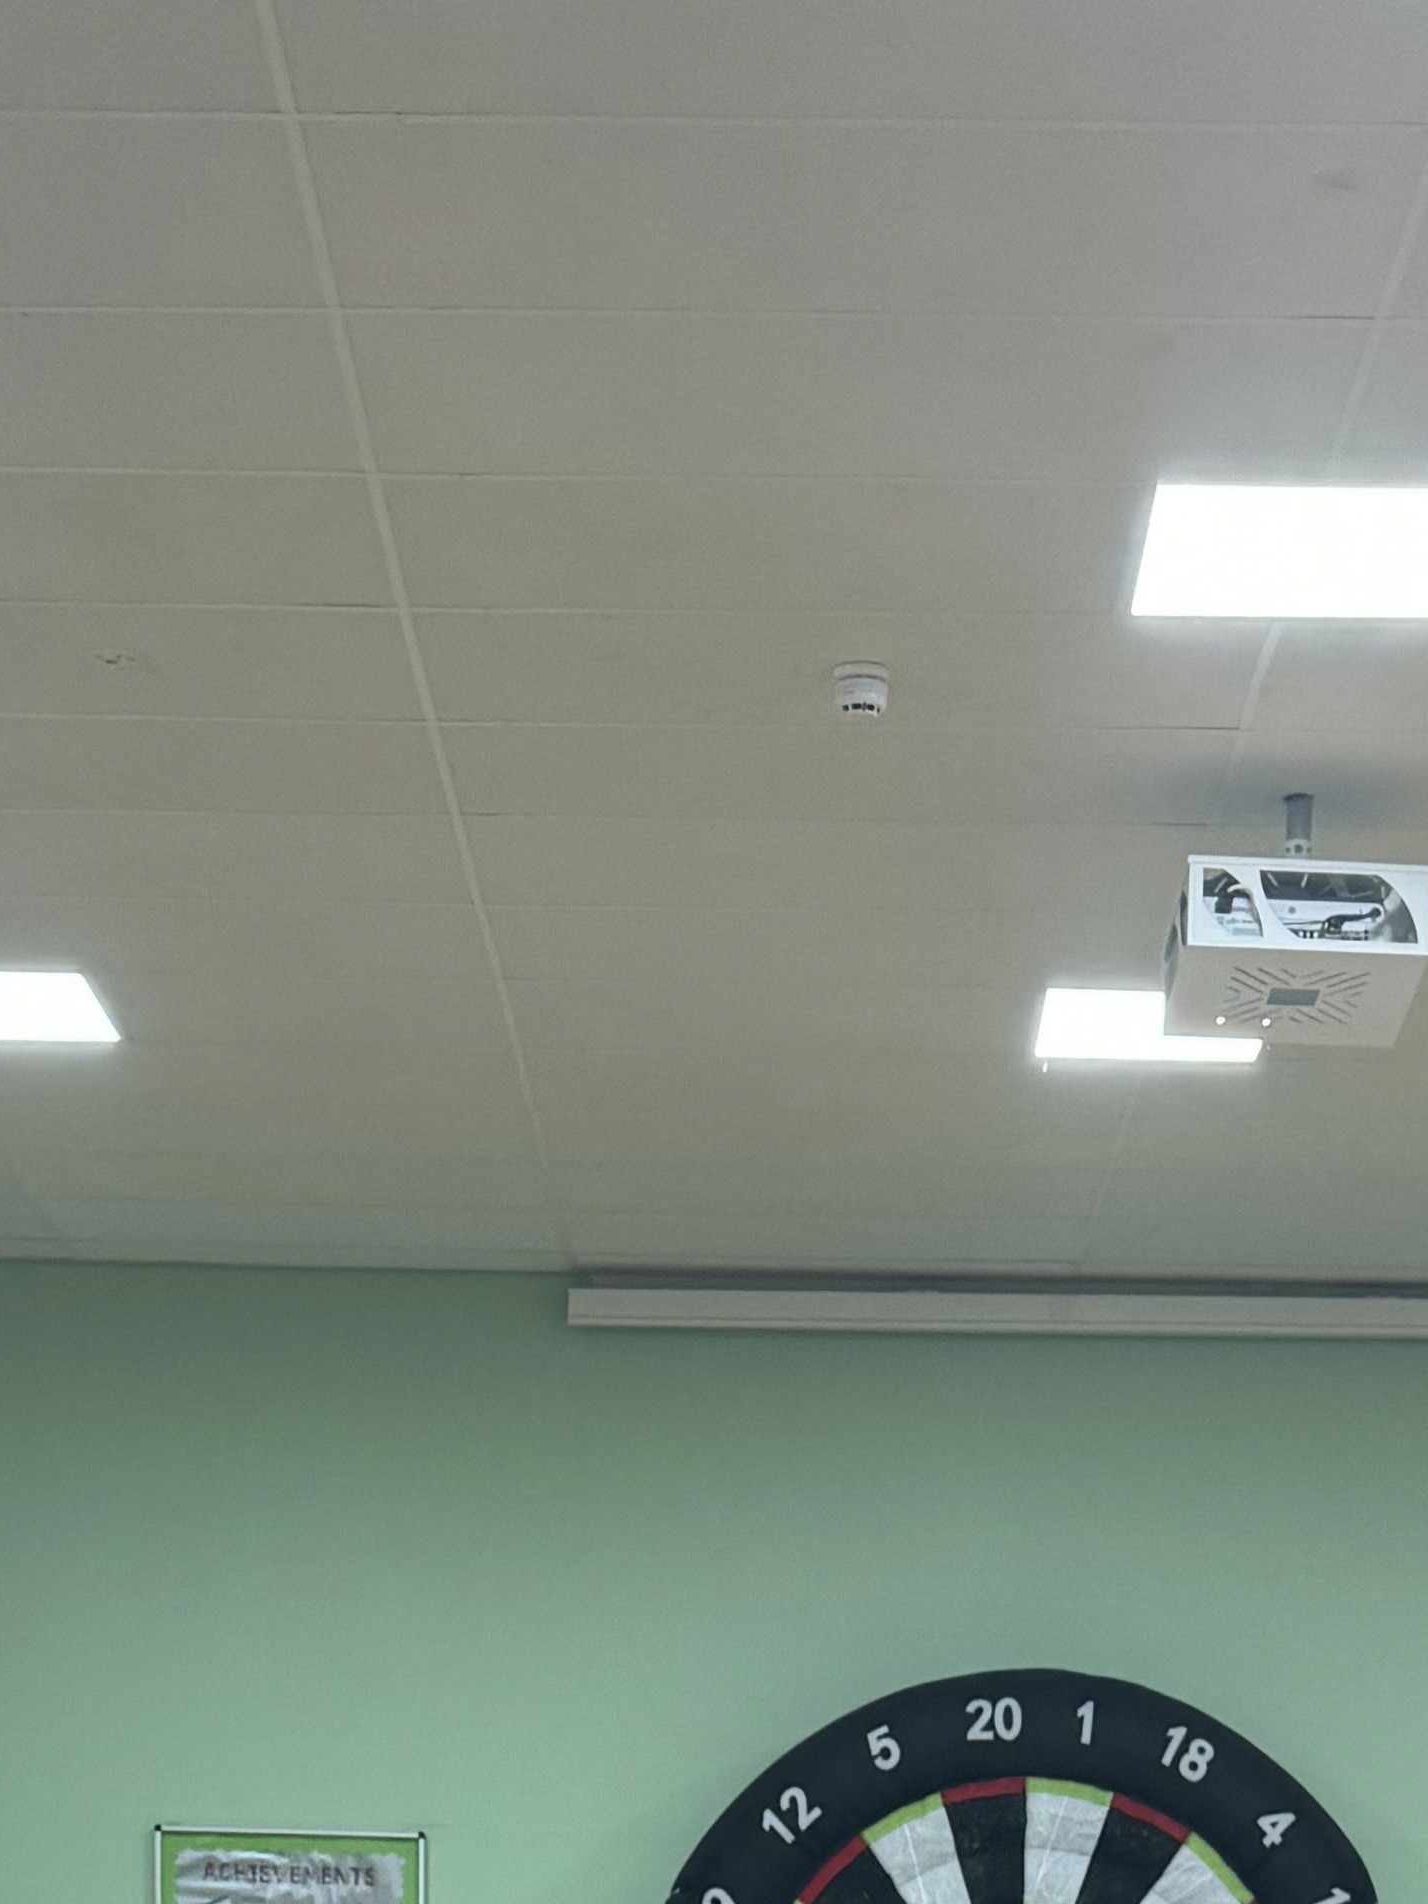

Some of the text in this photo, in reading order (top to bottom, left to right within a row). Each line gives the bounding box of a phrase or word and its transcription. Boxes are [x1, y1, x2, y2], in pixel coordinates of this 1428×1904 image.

[965, 1696, 1023, 1741] 20
[1076, 1700, 1095, 1745] 1
[866, 1724, 901, 1771] 5
[1161, 1723, 1215, 1783] 18
[761, 1786, 822, 1844] 12
[1256, 1812, 1296, 1848] 4
[203, 1861, 376, 1887] ACHIEVEMENTS
